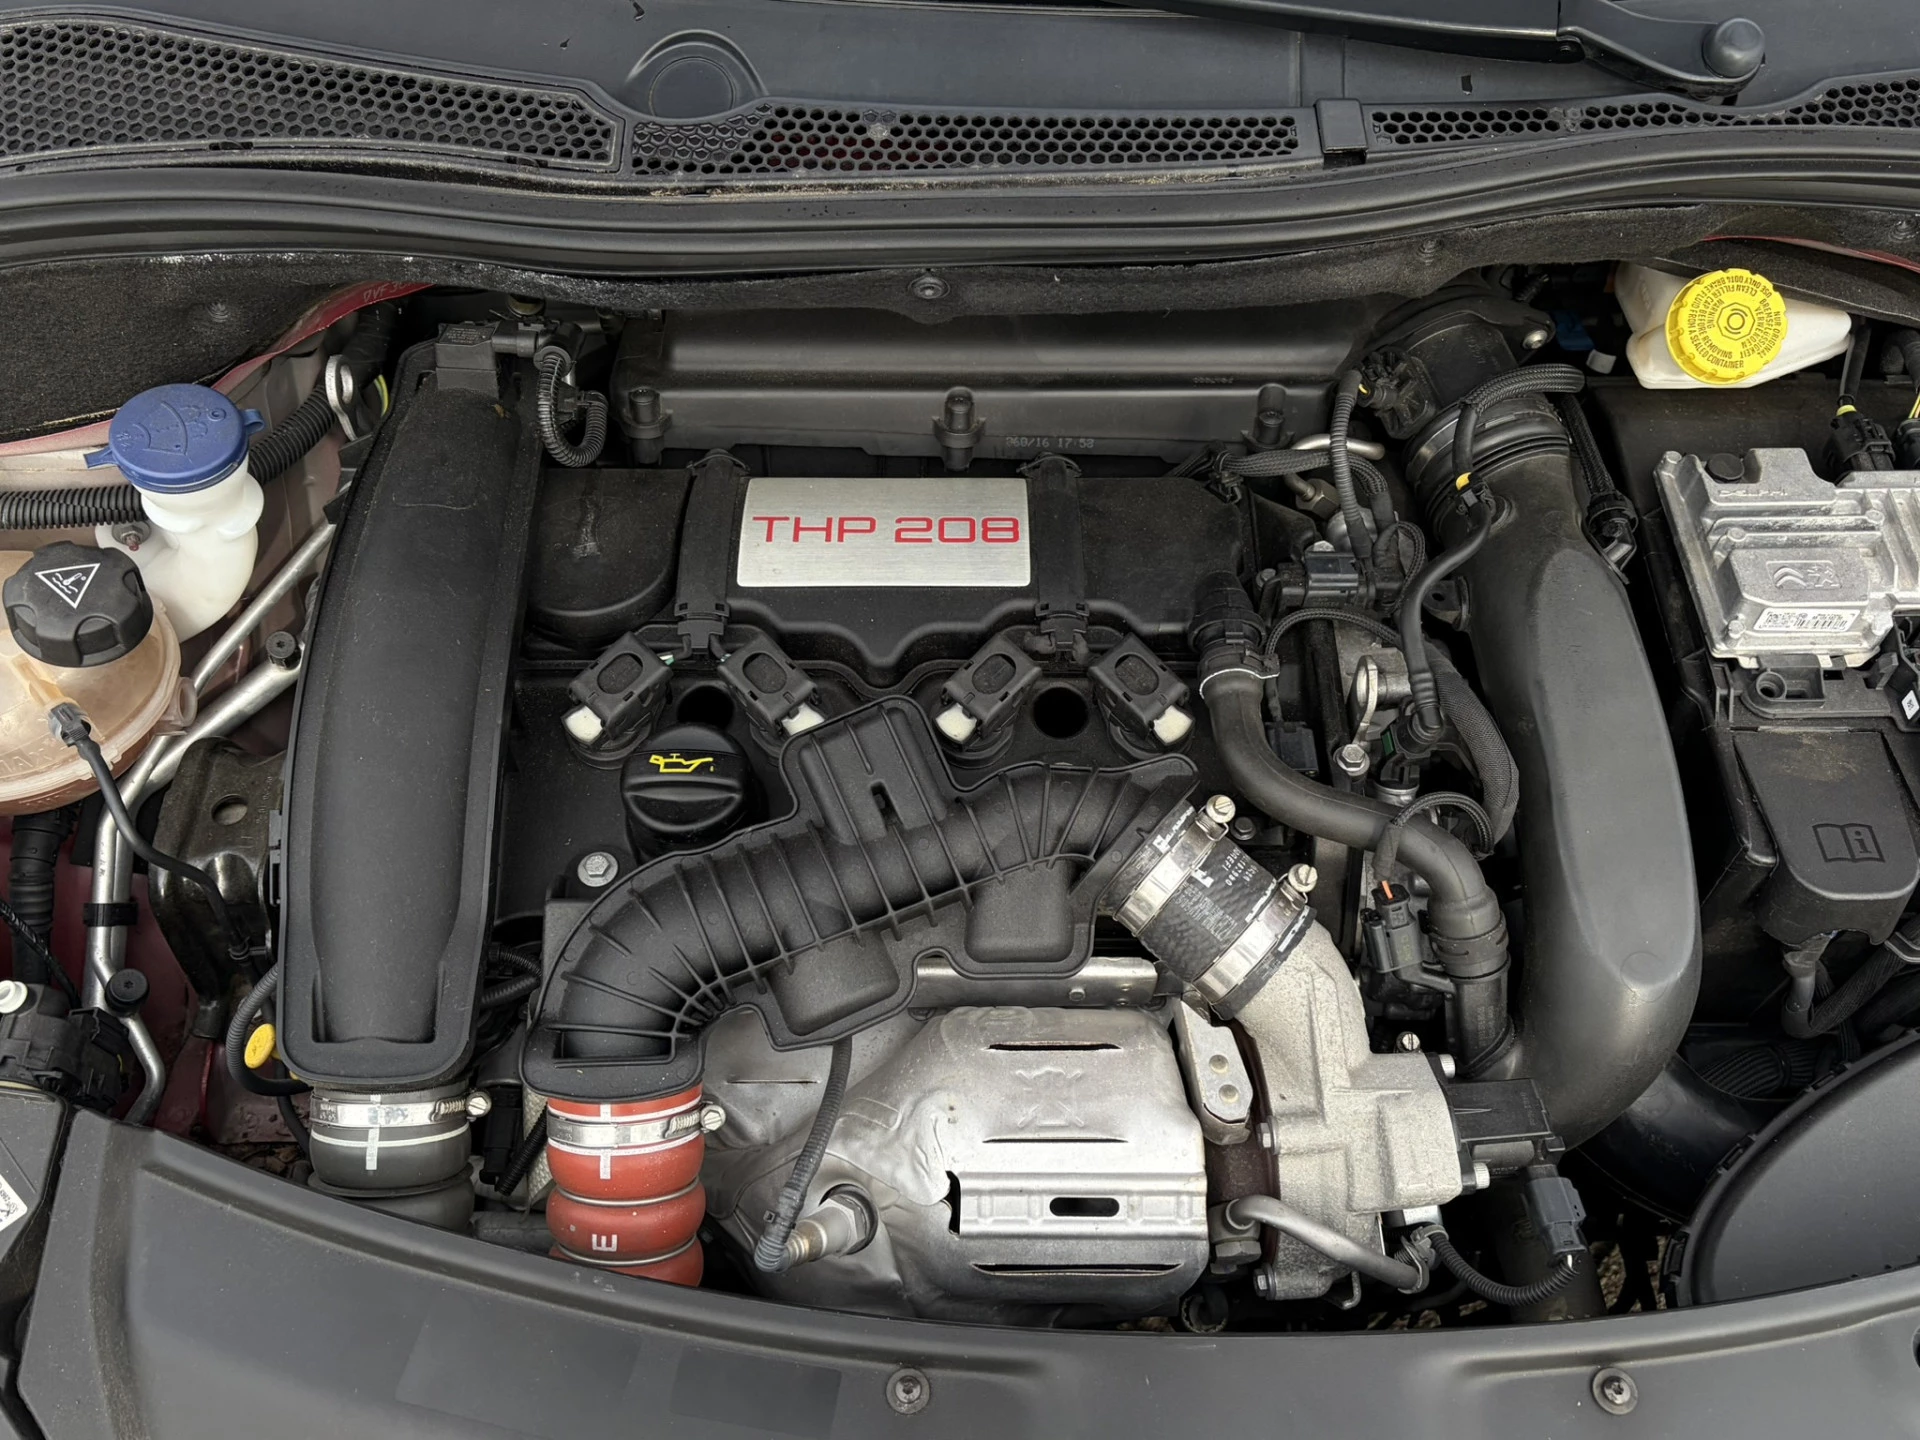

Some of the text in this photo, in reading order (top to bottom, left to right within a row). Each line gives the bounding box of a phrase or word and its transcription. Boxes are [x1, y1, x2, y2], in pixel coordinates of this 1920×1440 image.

[1705, 277, 1726, 291] BRAKE
[1726, 275, 1744, 283] DOT4
[1746, 277, 1761, 288] ONLY
[1691, 289, 1708, 309] FLUID
[1760, 285, 1772, 298] USE
[1687, 309, 1696, 330] FROM
[1697, 284, 1757, 360] CLEAN FILLER CAP BEFORE REMOVING
[1706, 298, 1725, 329] WARNING
[1741, 307, 1764, 349] VERWENDEN
[1758, 311, 1781, 358] NUR ORIGINAL
[1690, 334, 1708, 358] SEALED
[1707, 354, 1744, 369] CONTAINER
[752, 516, 1020, 544] THP 208
[591, 1233, 617, 1252] E
